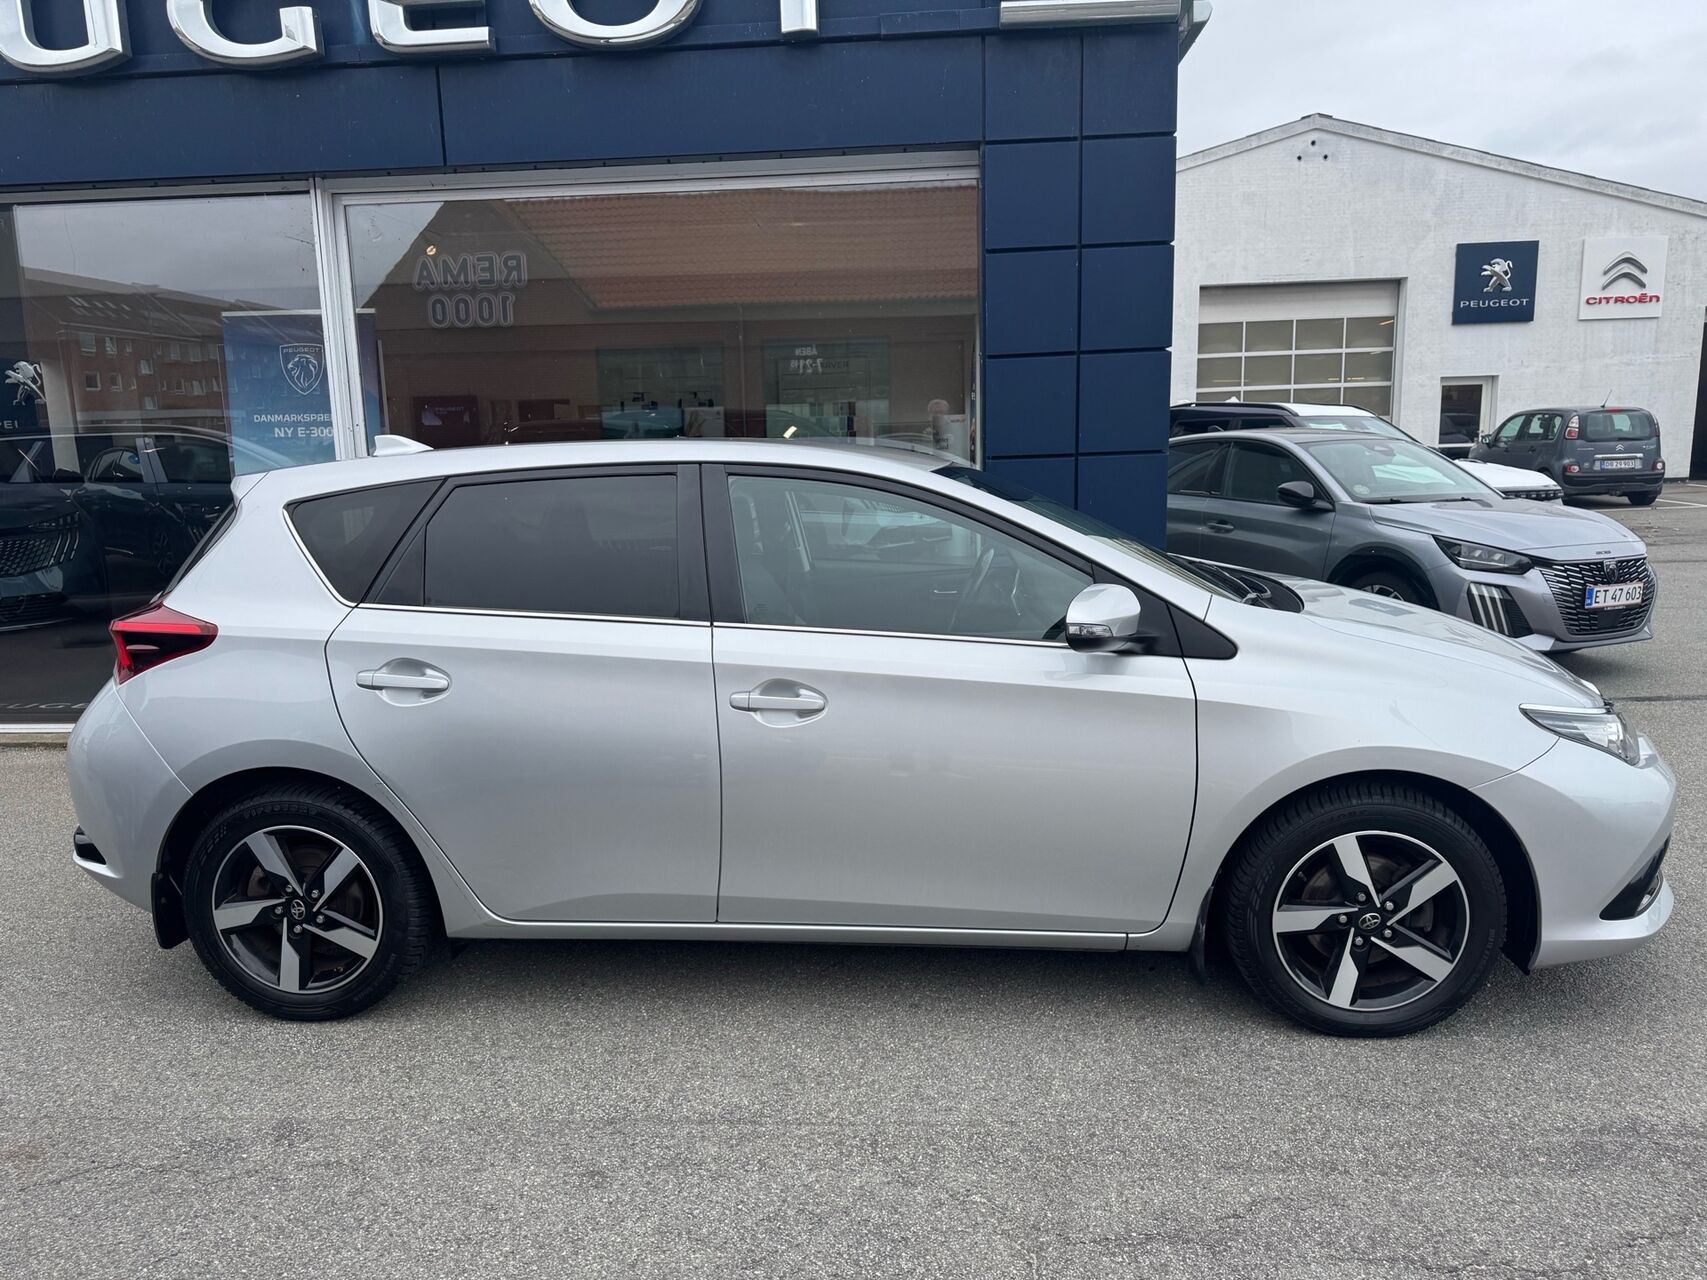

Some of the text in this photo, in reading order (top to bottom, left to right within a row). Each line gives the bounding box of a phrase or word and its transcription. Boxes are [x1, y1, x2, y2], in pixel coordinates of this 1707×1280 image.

[1460, 298, 1529, 308] PEUGEOT
[274, 427, 294, 437] NY
[1594, 586, 1641, 604] ET 47 603
